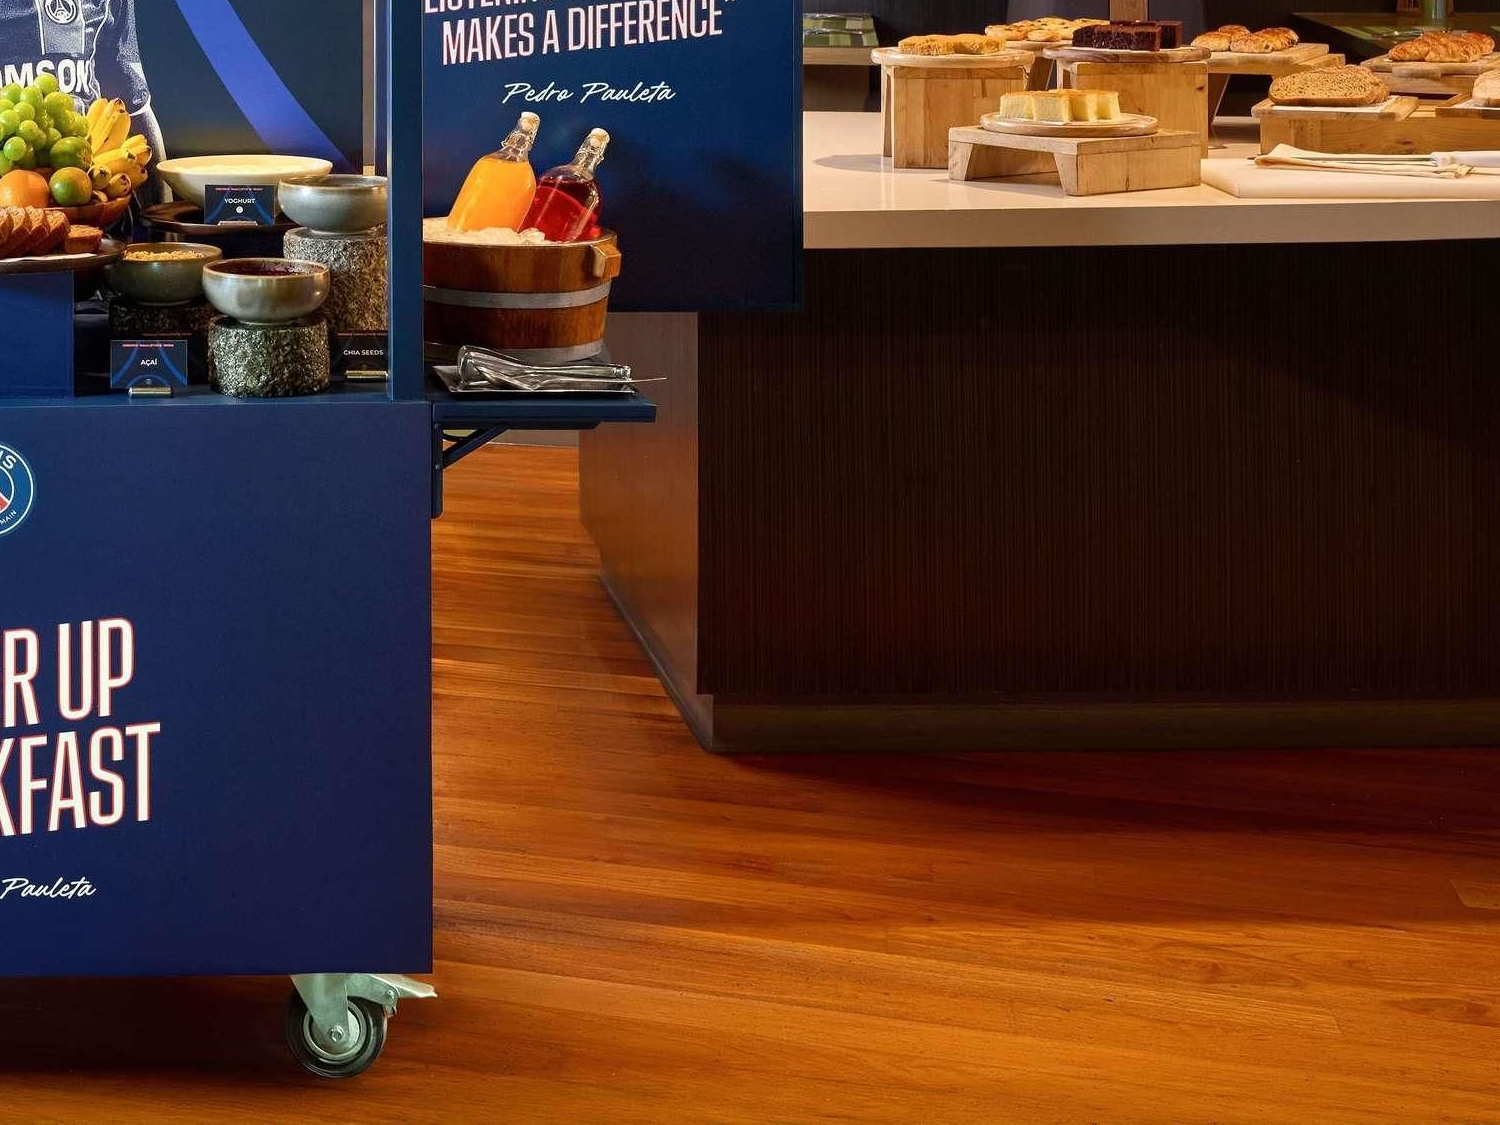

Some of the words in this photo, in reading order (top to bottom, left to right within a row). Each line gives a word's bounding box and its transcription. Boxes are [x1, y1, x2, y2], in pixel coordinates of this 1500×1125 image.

[442, 11, 534, 66] MAKES
[542, 9, 560, 55] A
[502, 81, 574, 104] Pedro
[580, 80, 676, 104] Pauleta
[57, 617, 135, 722] UP
[0, 876, 97, 900] Pauleta
